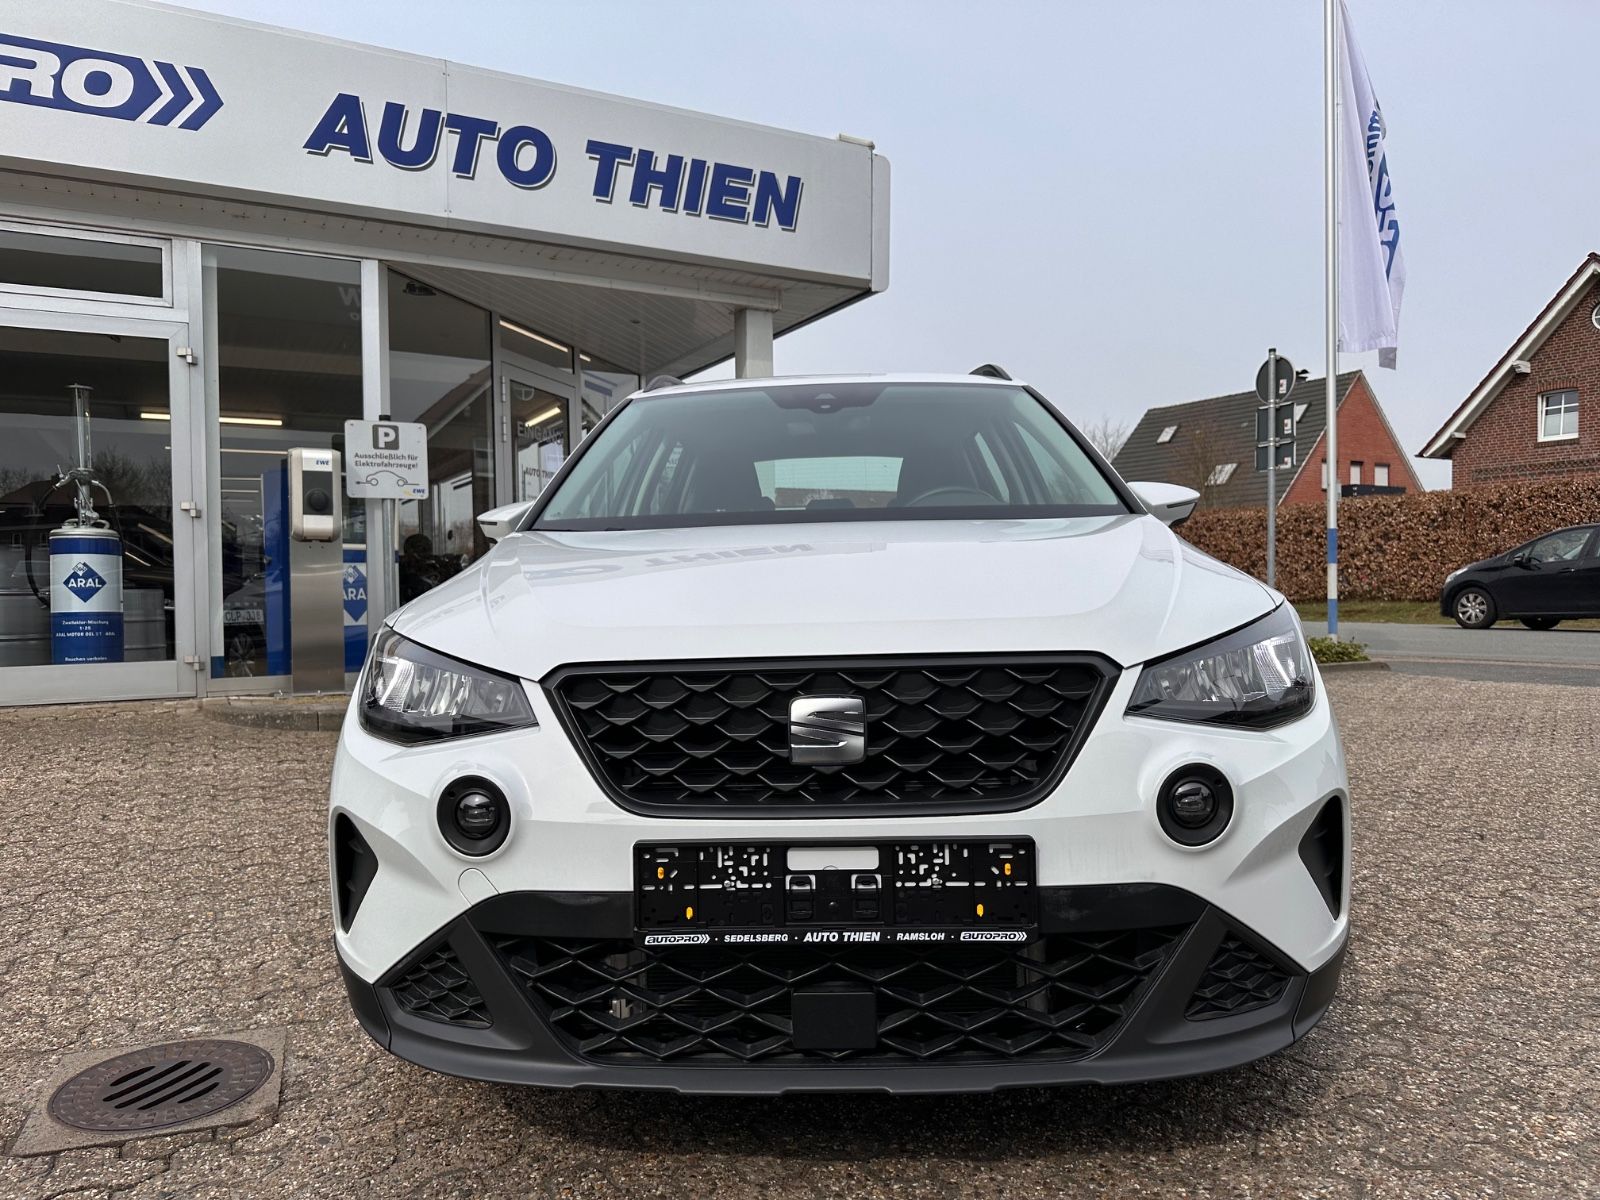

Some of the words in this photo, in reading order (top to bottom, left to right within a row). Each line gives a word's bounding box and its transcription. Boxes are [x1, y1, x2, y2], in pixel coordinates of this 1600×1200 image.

[0, 43, 134, 108] RO
[303, 92, 557, 190] AUTO
[586, 139, 803, 232] THIEN
[378, 426, 396, 448] P
[354, 452, 407, 461] Ausschließlich
[408, 453, 418, 461] für
[354, 460, 418, 471] Elektrofahrzeuge!
[68, 578, 102, 588] ARAL
[343, 587, 367, 600] ARA
[723, 933, 789, 943] SEDELSBERG
[803, 932, 839, 942] AUTO
[843, 932, 881, 942] THIEN
[896, 932, 945, 941] RAMSLOH
